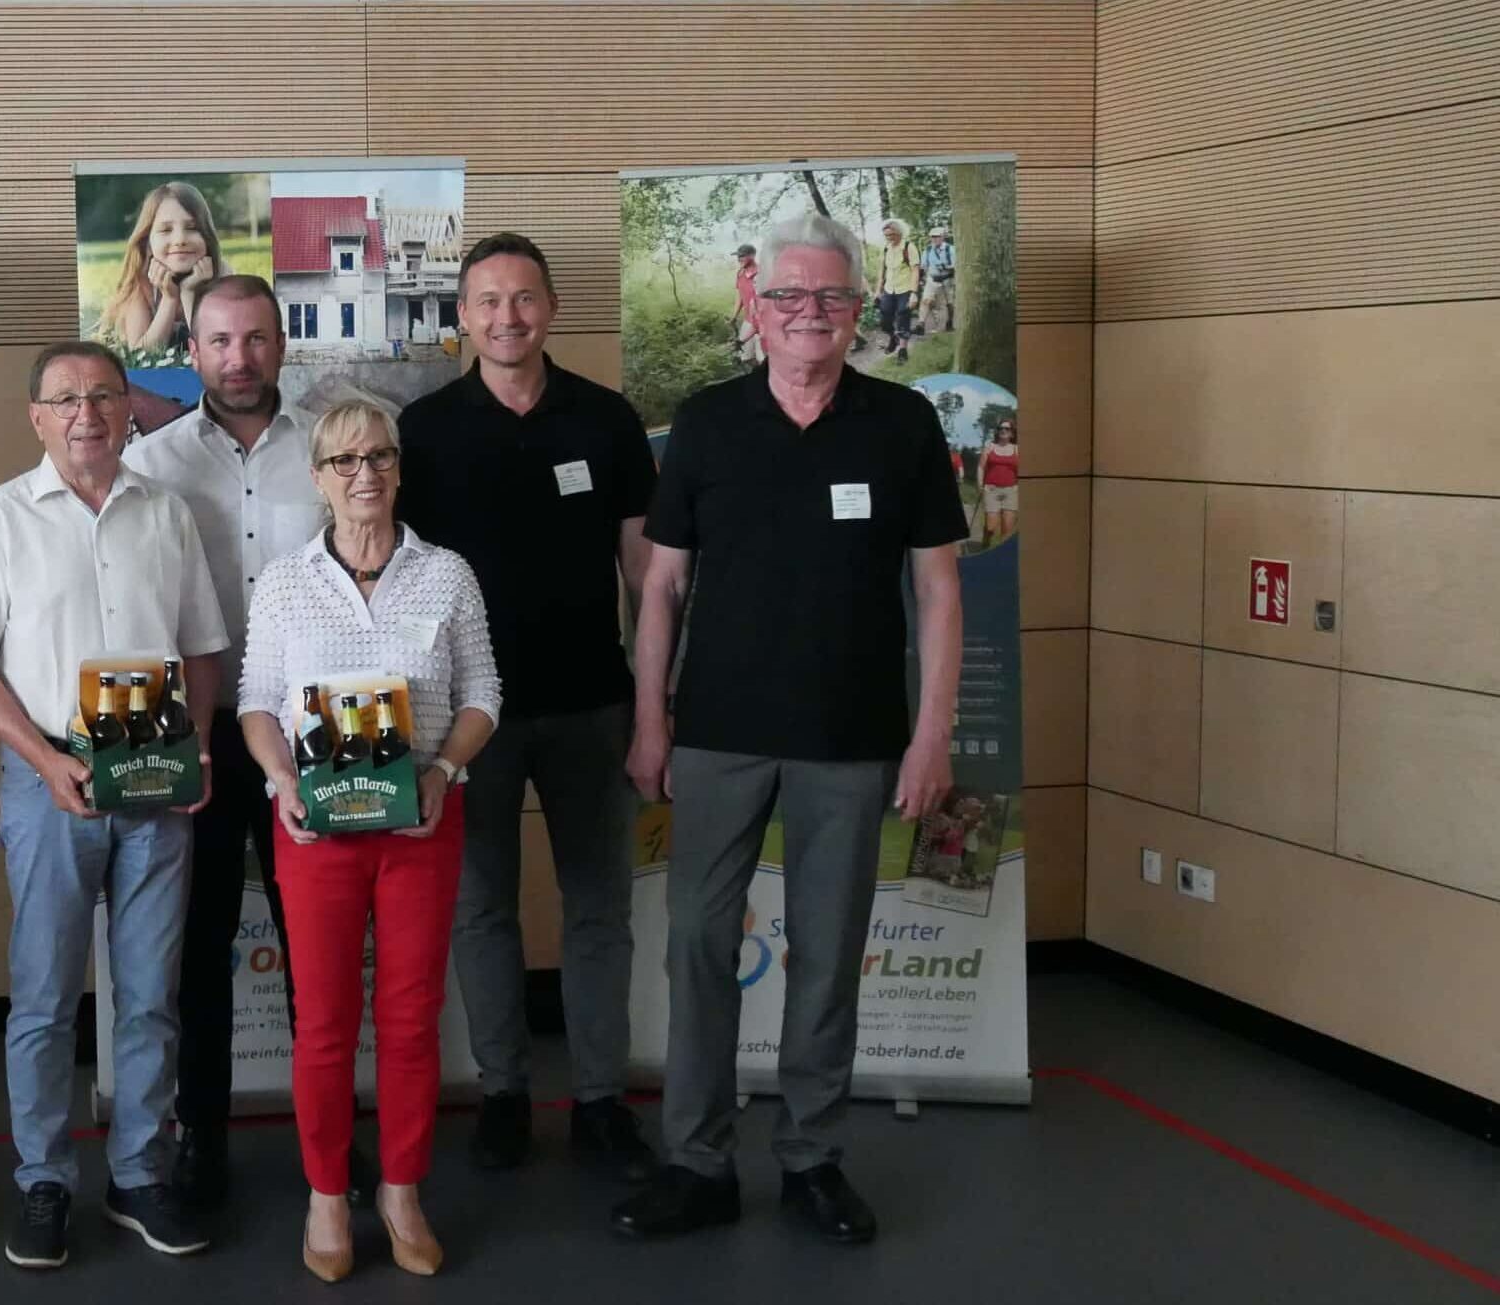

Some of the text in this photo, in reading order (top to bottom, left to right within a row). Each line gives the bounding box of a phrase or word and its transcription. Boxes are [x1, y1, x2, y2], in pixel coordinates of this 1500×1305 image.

[110, 755, 186, 779] Ulrich Martin
[313, 777, 398, 802] Ulrich Martin
